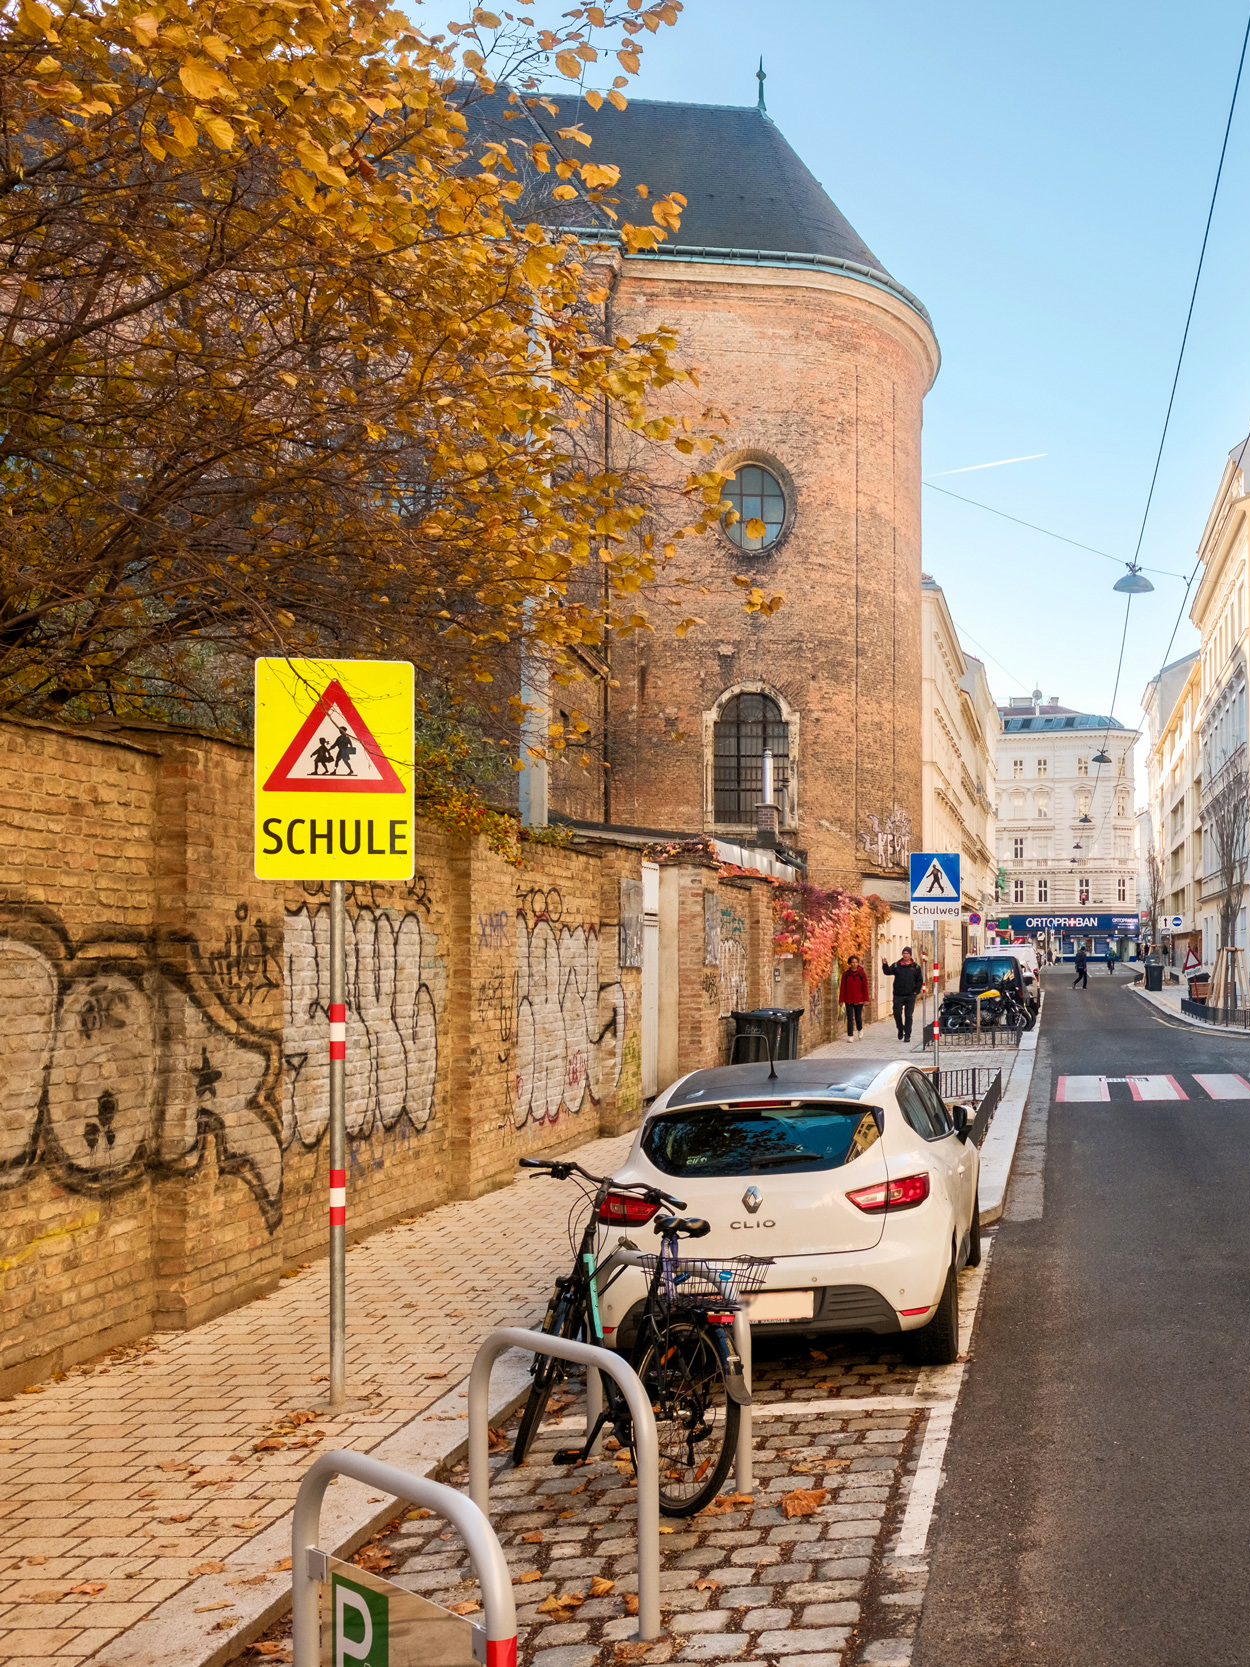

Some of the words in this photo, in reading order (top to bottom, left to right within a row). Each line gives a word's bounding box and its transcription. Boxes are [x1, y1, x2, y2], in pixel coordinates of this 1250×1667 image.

[262, 818, 408, 855] SCHULE
[912, 906, 960, 916] Schulweg
[730, 1220, 776, 1229] CLIO
[336, 1584, 373, 1667] P
